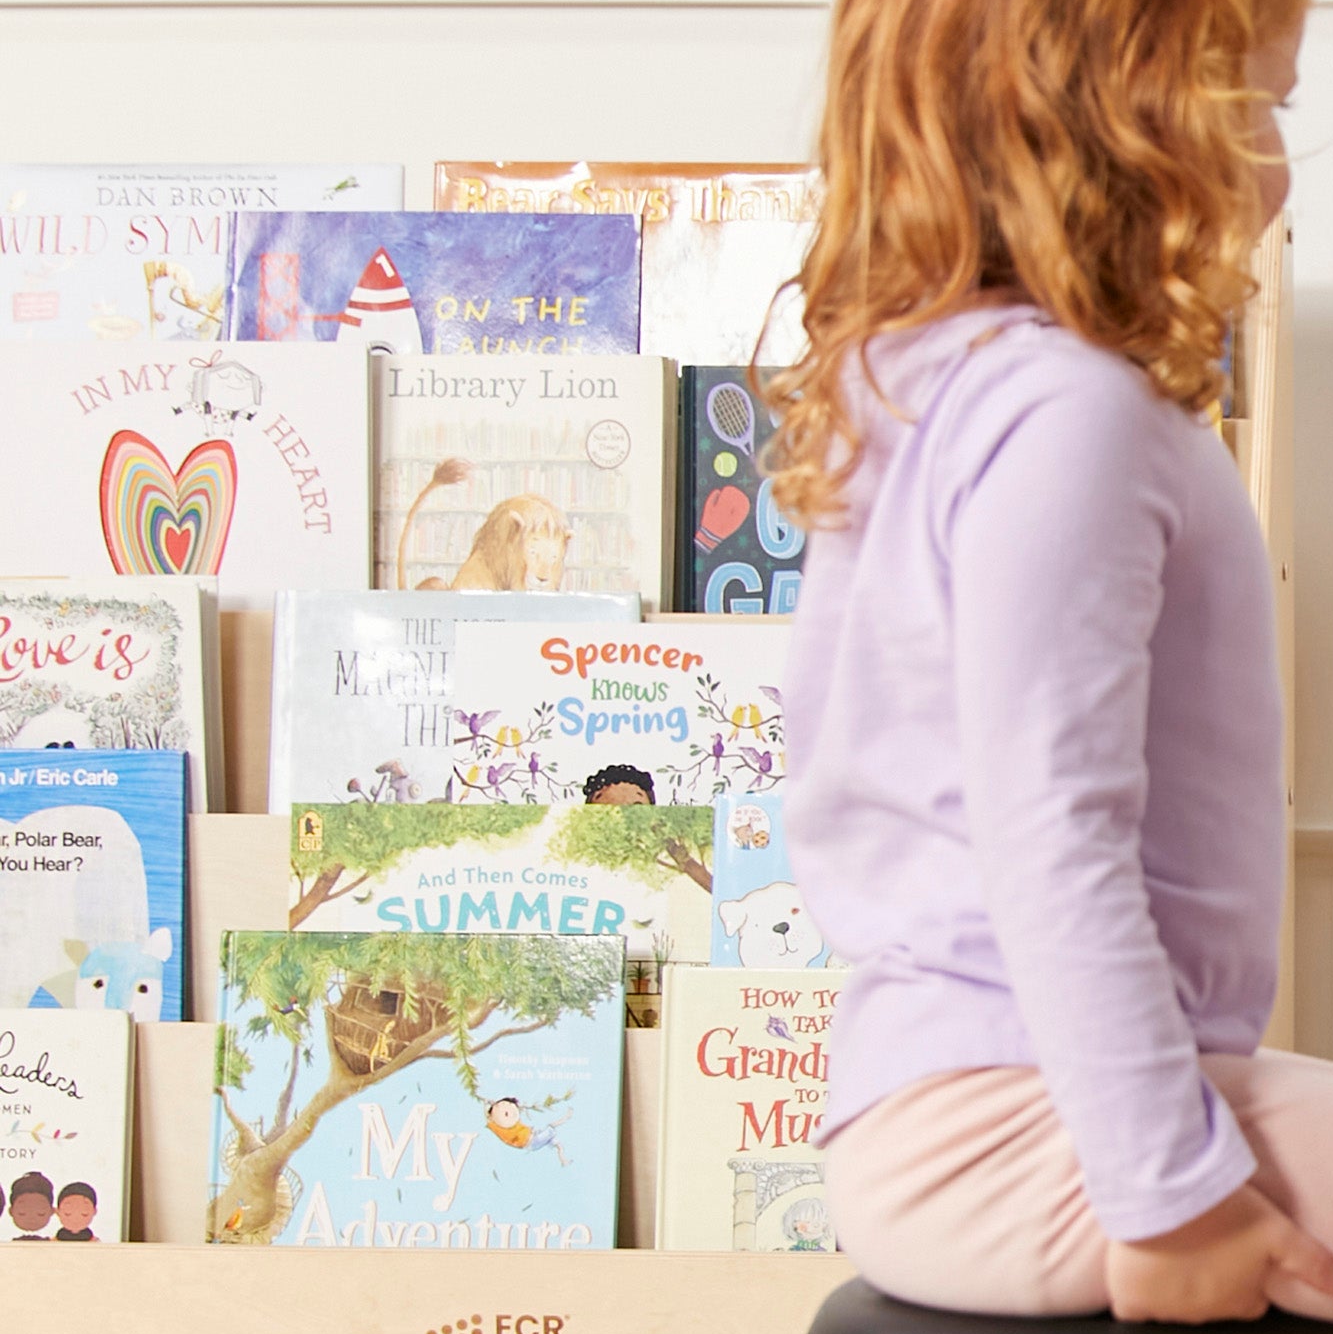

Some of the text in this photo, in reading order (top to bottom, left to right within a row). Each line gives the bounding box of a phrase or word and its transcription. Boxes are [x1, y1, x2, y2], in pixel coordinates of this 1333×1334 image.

[97, 187, 278, 207] DAN BROWN
[456, 177, 561, 213] Bear
[572, 178, 671, 222] Says
[0, 215, 108, 255] WILD
[434, 296, 589, 326] ON THE
[389, 368, 619, 408] Library Lion
[71, 364, 332, 535] IN MY HEART
[401, 618, 442, 645] THE
[94, 628, 150, 680] is
[540, 637, 703, 680] Spencer
[557, 697, 689, 746] Spring
[73, 768, 119, 786] Carle
[15, 832, 57, 847] Polar
[62, 832, 103, 850] Bear,
[0, 856, 84, 871] You Hear?
[417, 866, 588, 889] And Then Comes
[377, 891, 626, 935] SUMMER
[740, 987, 802, 1009] HOW
[795, 1088, 820, 1104] TO
[352, 1102, 479, 1212] My
[295, 1181, 592, 1249] Adventure
